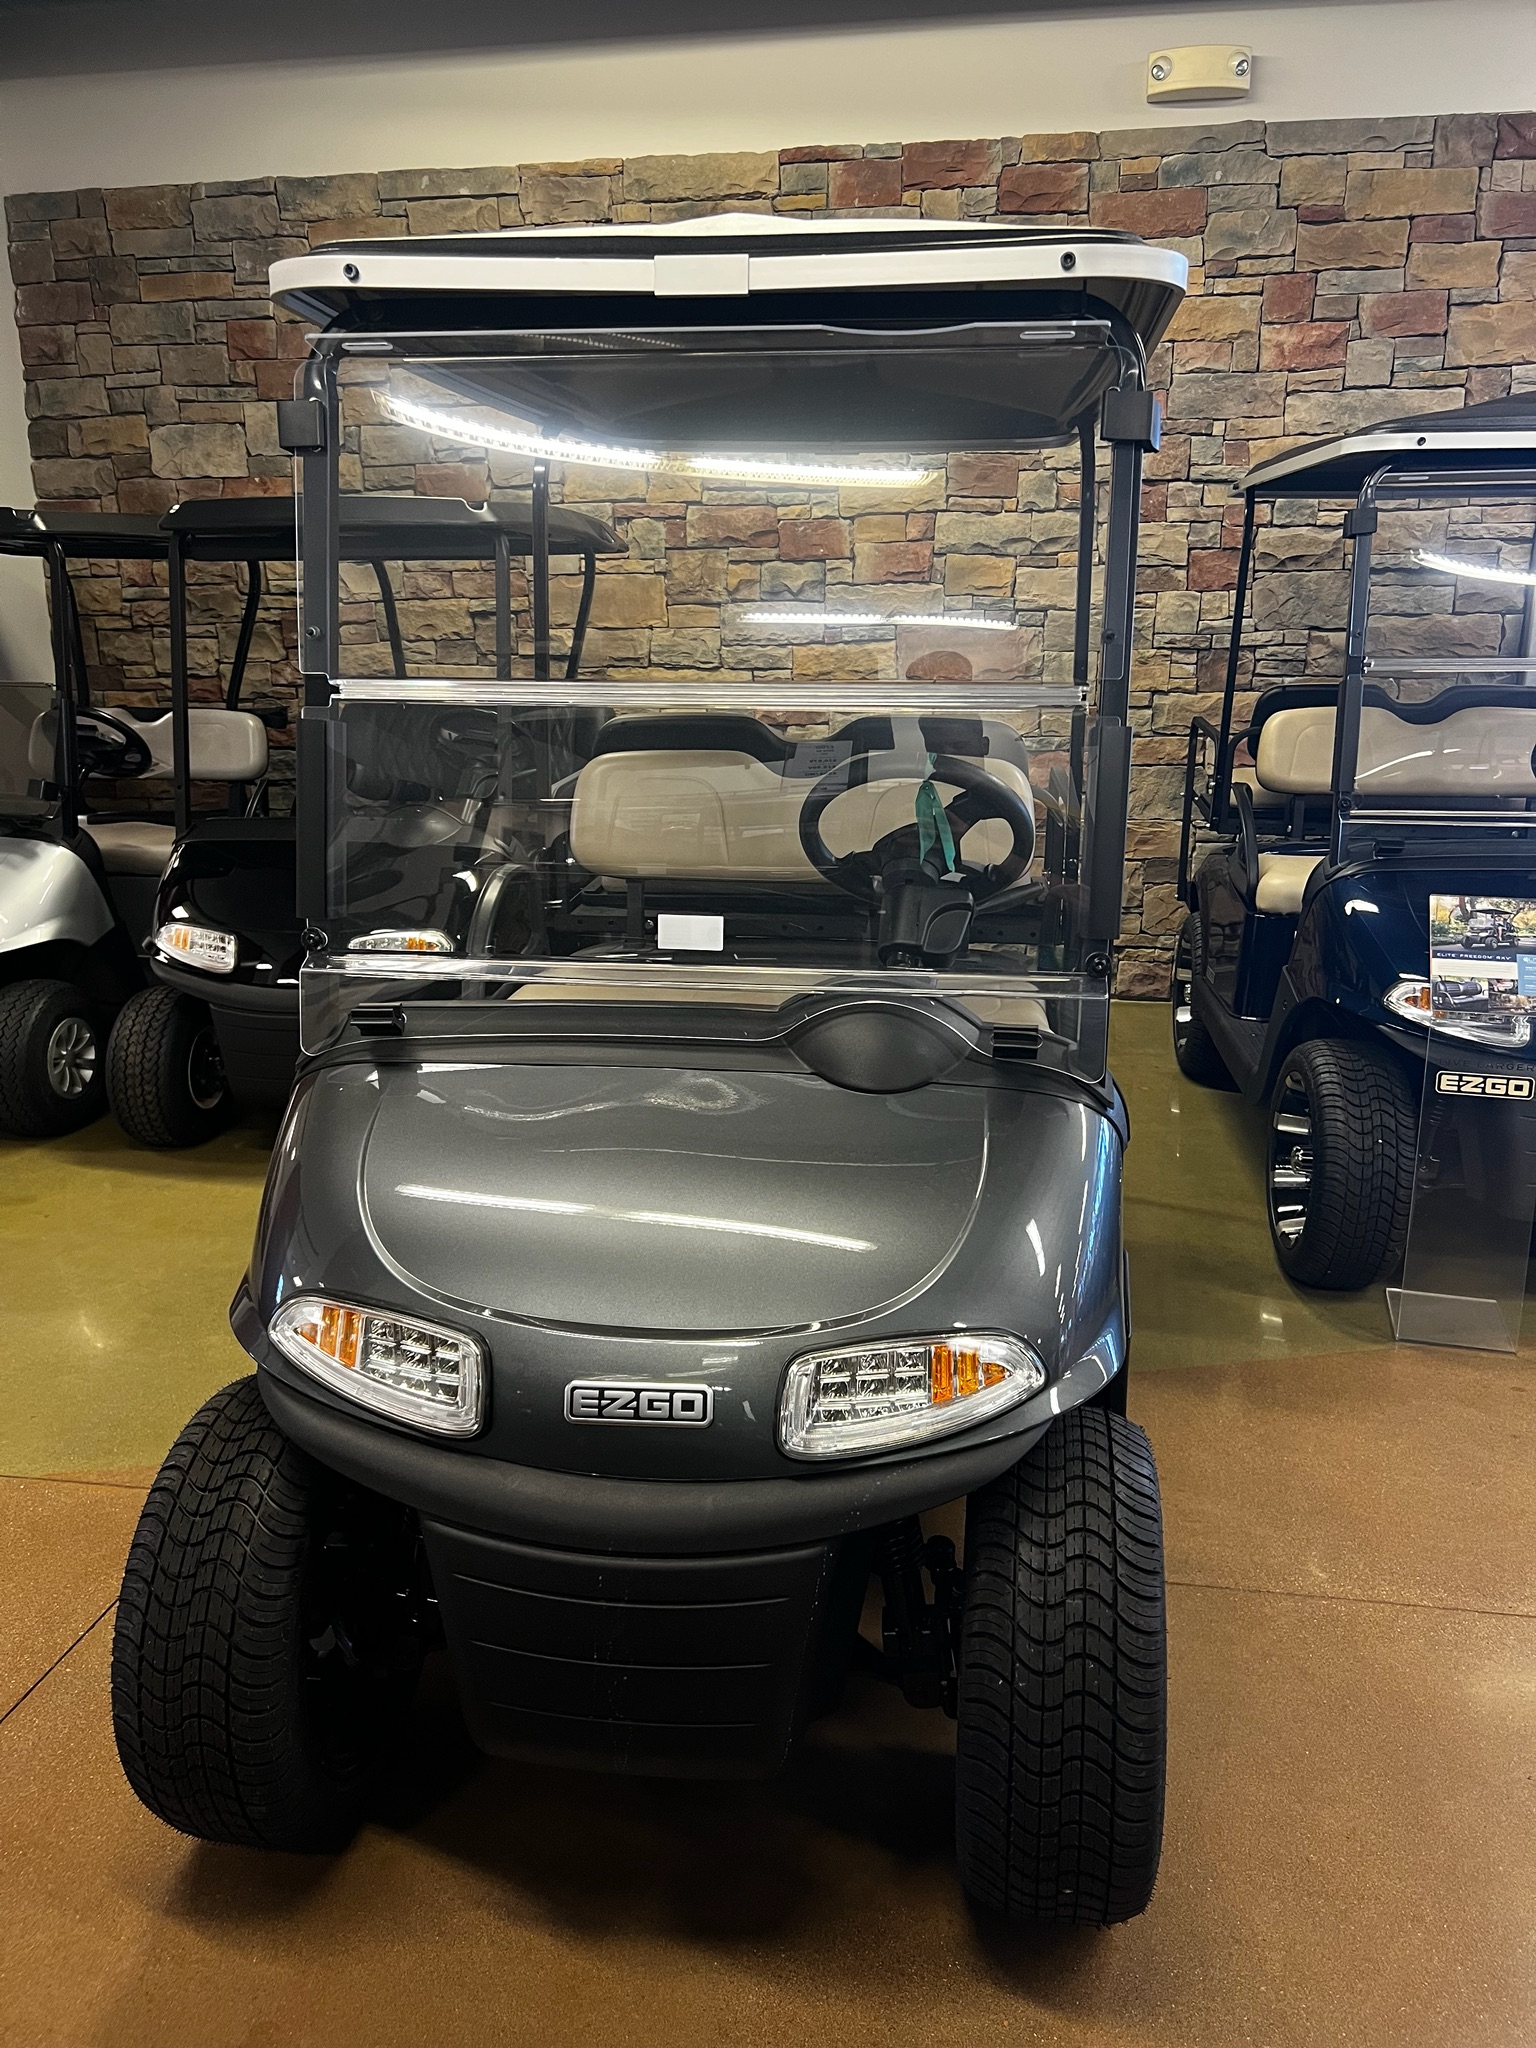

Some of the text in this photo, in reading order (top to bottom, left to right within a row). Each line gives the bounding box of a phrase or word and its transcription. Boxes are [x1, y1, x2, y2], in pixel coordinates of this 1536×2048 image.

[1477, 1060, 1536, 1072] LARGER
[1440, 1074, 1530, 1097] EZGO
[571, 1388, 705, 1421] EZGO
